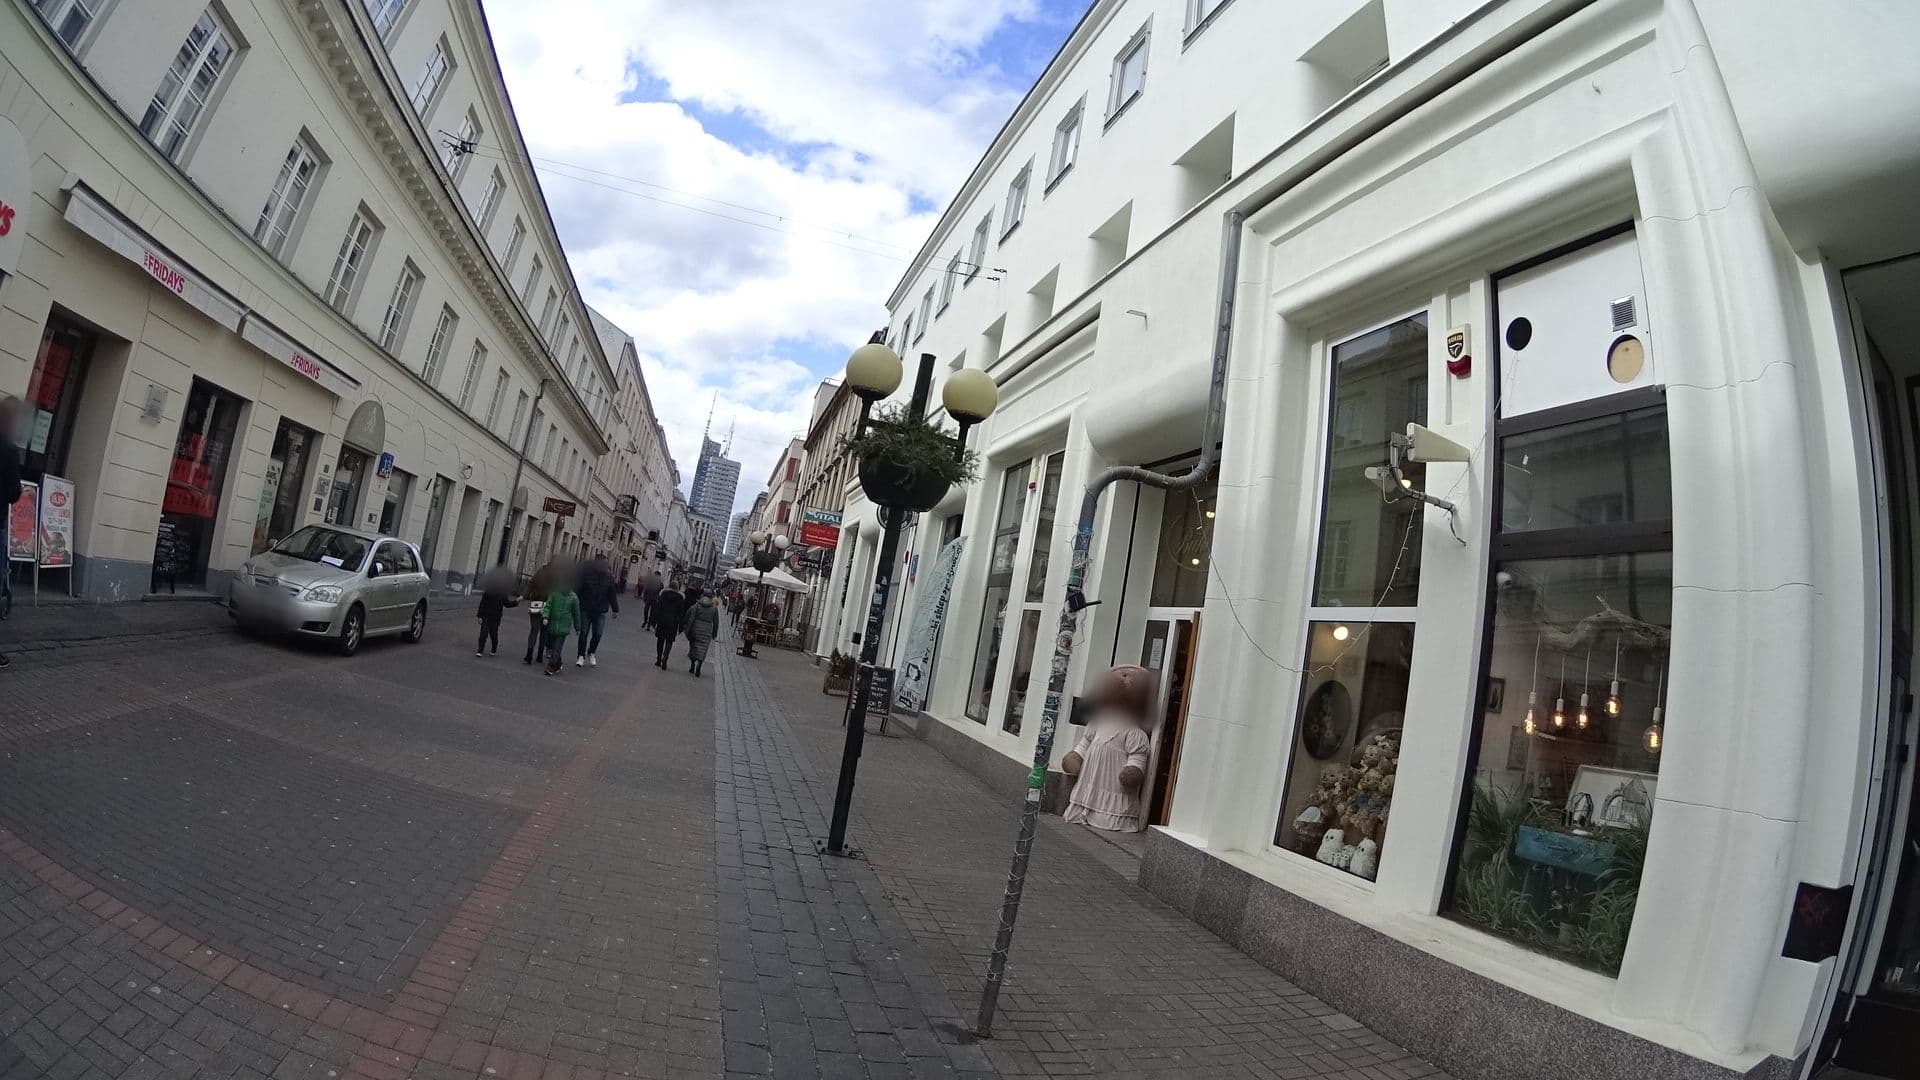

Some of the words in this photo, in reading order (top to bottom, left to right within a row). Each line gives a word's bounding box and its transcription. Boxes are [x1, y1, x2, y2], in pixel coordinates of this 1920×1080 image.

[148, 255, 185, 293] FRIDAYS
[294, 355, 321, 380] FRIDAYS
[932, 594, 948, 620] sklep
